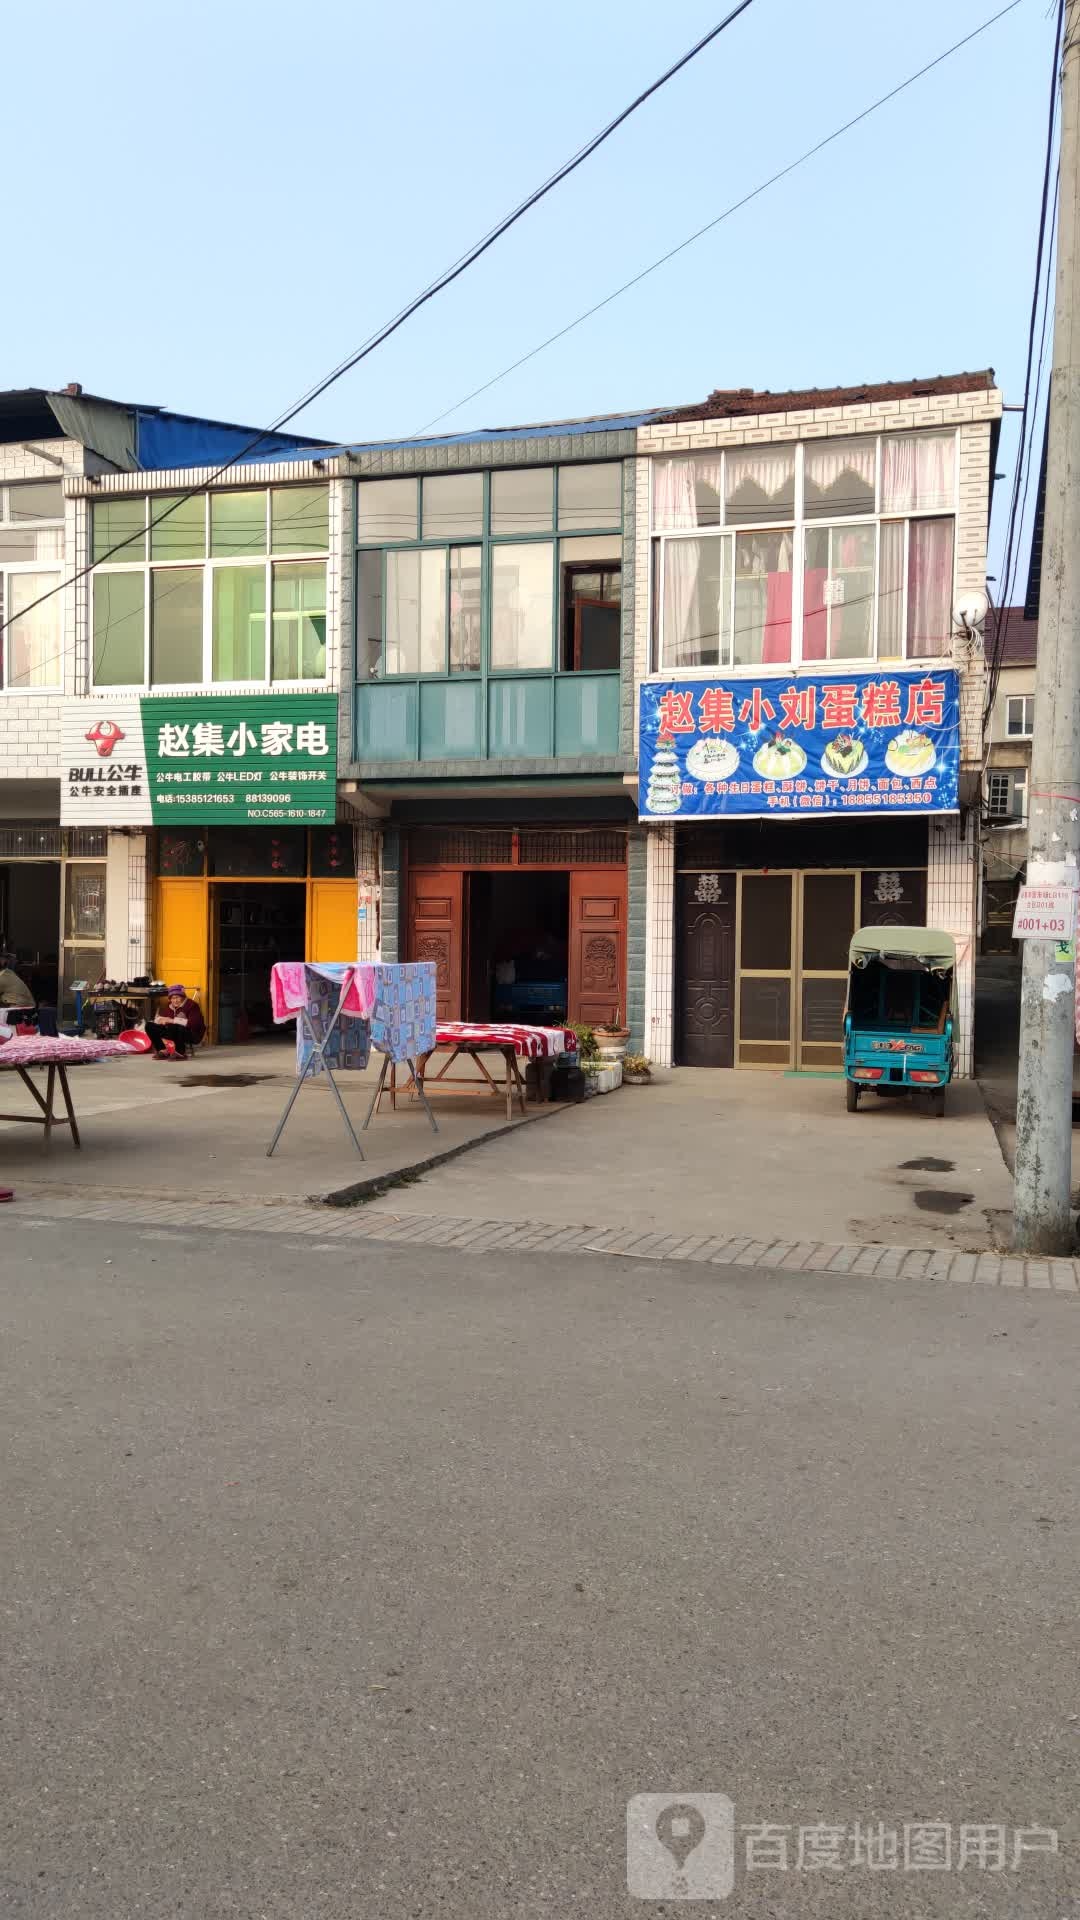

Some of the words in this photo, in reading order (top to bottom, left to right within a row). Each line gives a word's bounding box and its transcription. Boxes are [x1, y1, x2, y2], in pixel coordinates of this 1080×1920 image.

[658, 679, 946, 734] 赵集小刘蛋糕店
[157, 721, 330, 758] 赵集小家电
[156, 772, 211, 783] 公牛电工胶带
[217, 771, 262, 782] 公牛LED灯
[269, 770, 327, 781] 公牛装饰开关
[69, 785, 143, 797] 公牛安全插座
[1017, 918, 1065, 932] #001+03
